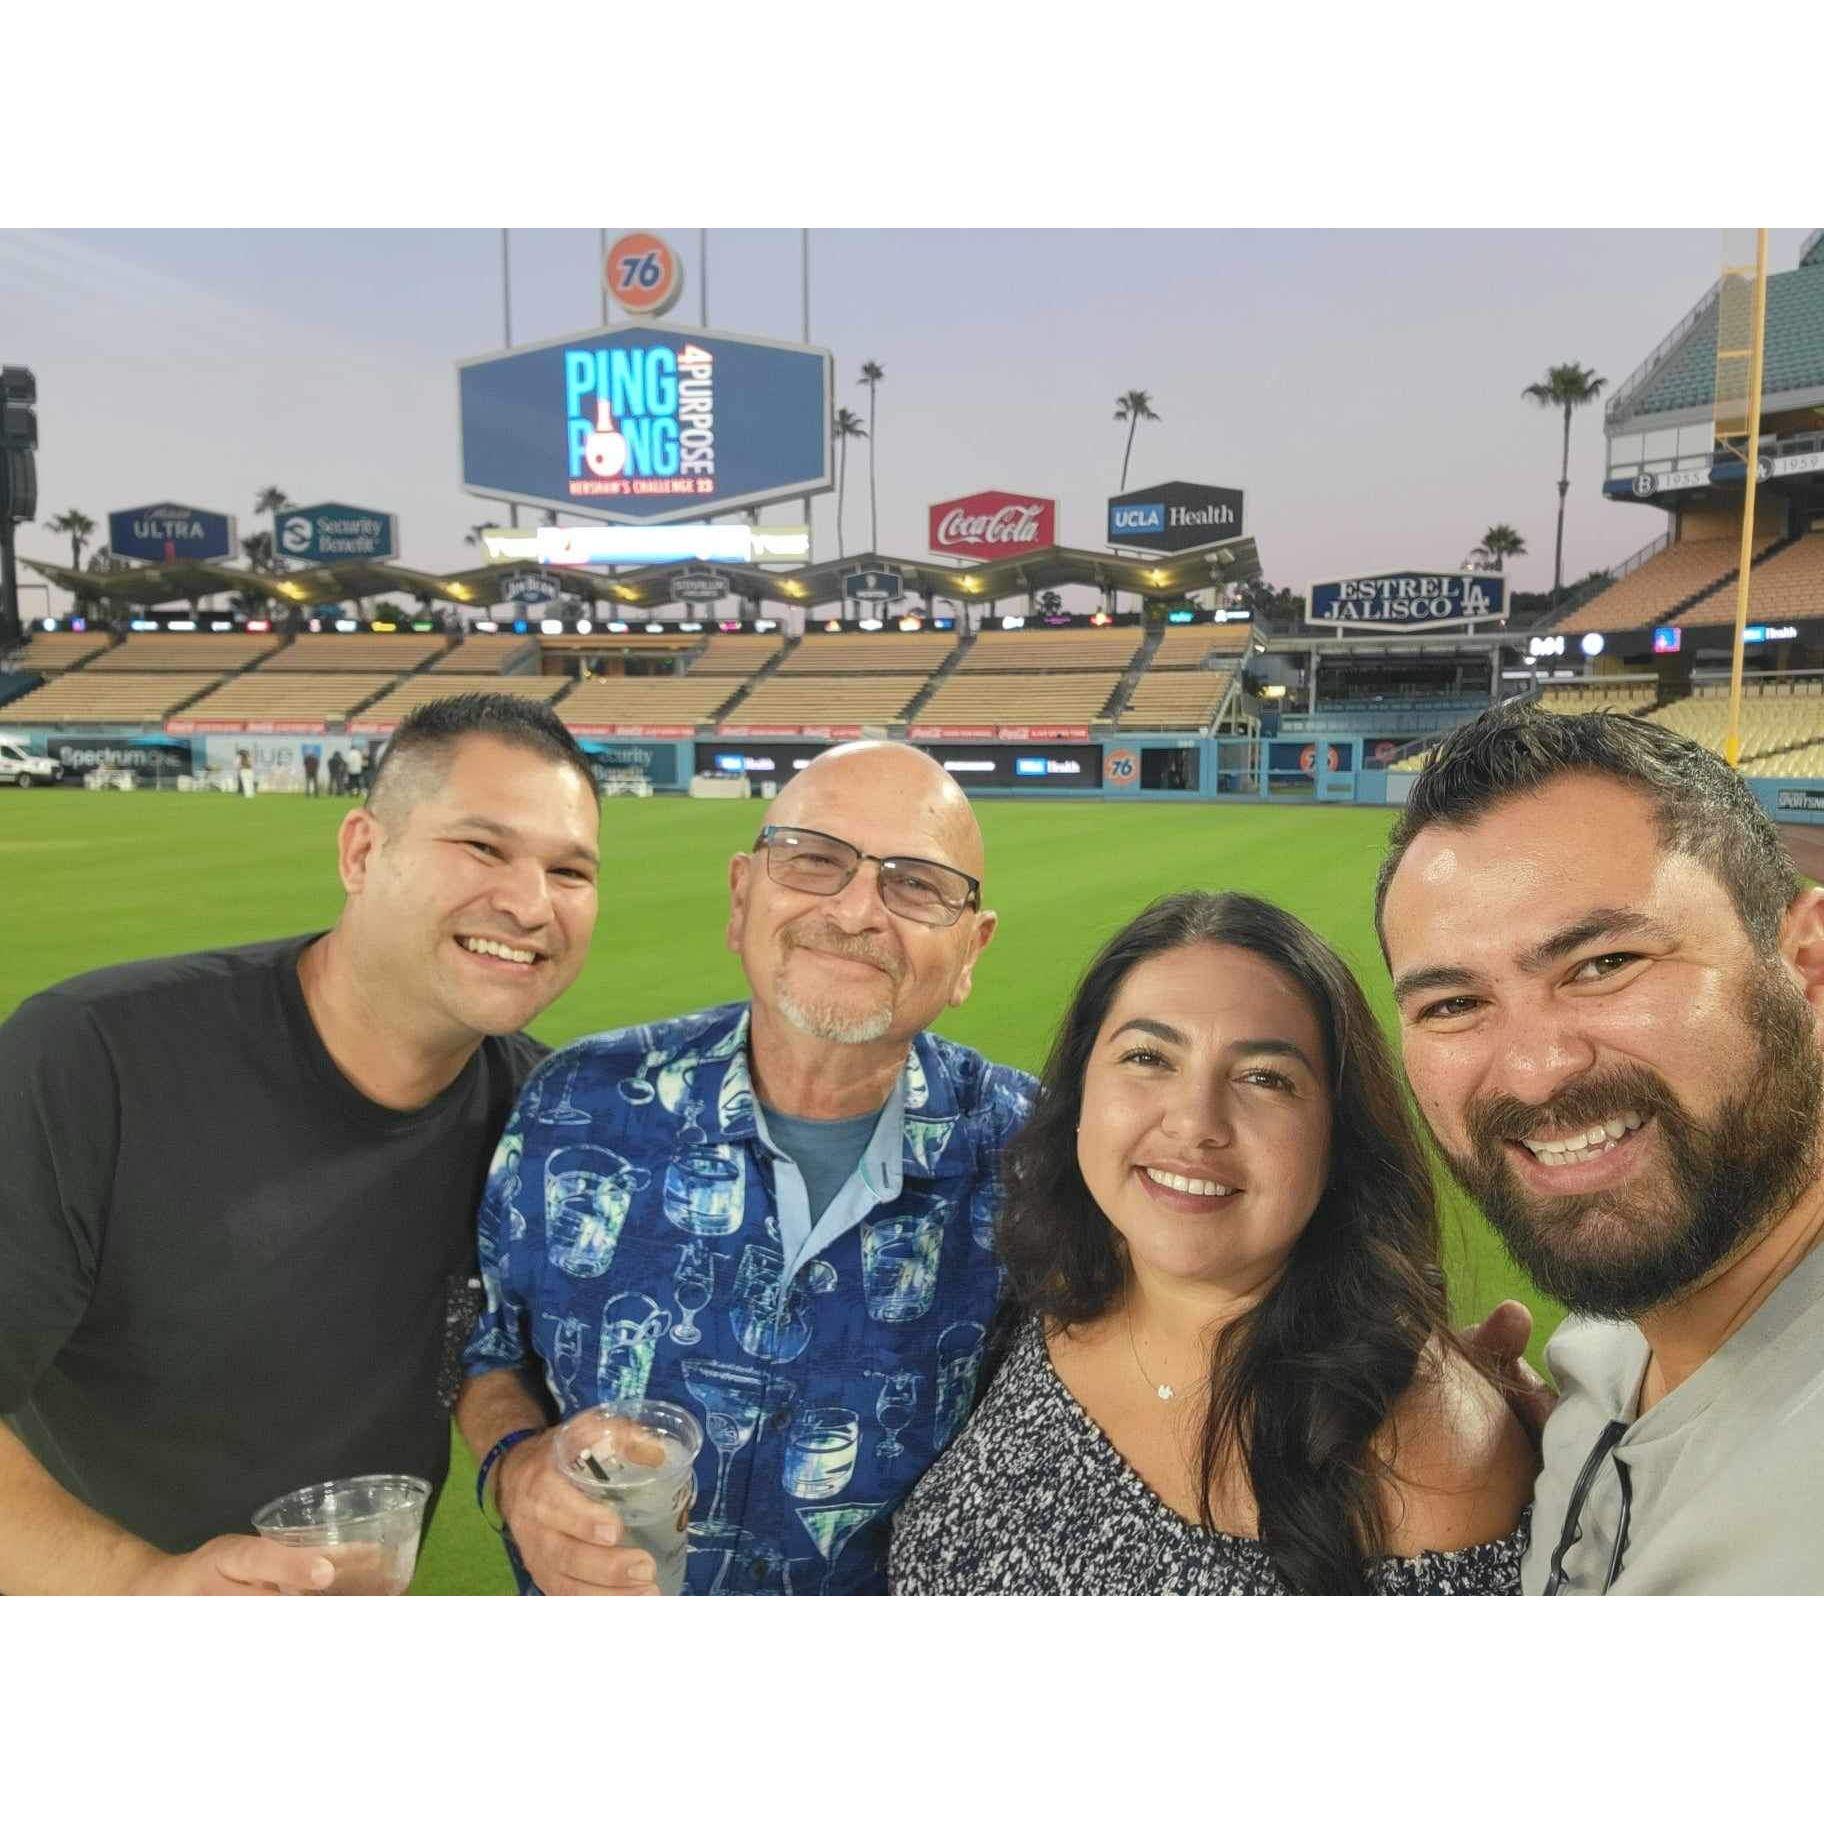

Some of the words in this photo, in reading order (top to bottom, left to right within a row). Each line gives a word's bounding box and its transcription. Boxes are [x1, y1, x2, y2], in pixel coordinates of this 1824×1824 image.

[620, 251, 661, 288] 76
[564, 345, 677, 417] PING
[316, 516, 383, 538] Security
[1115, 509, 1160, 528] UCLA
[1169, 504, 1235, 526] Health
[133, 520, 205, 539] ULTRA
[1323, 596, 1453, 620] JALISCO
[60, 746, 147, 770] Spectrum
[1111, 760, 1132, 776] 76
